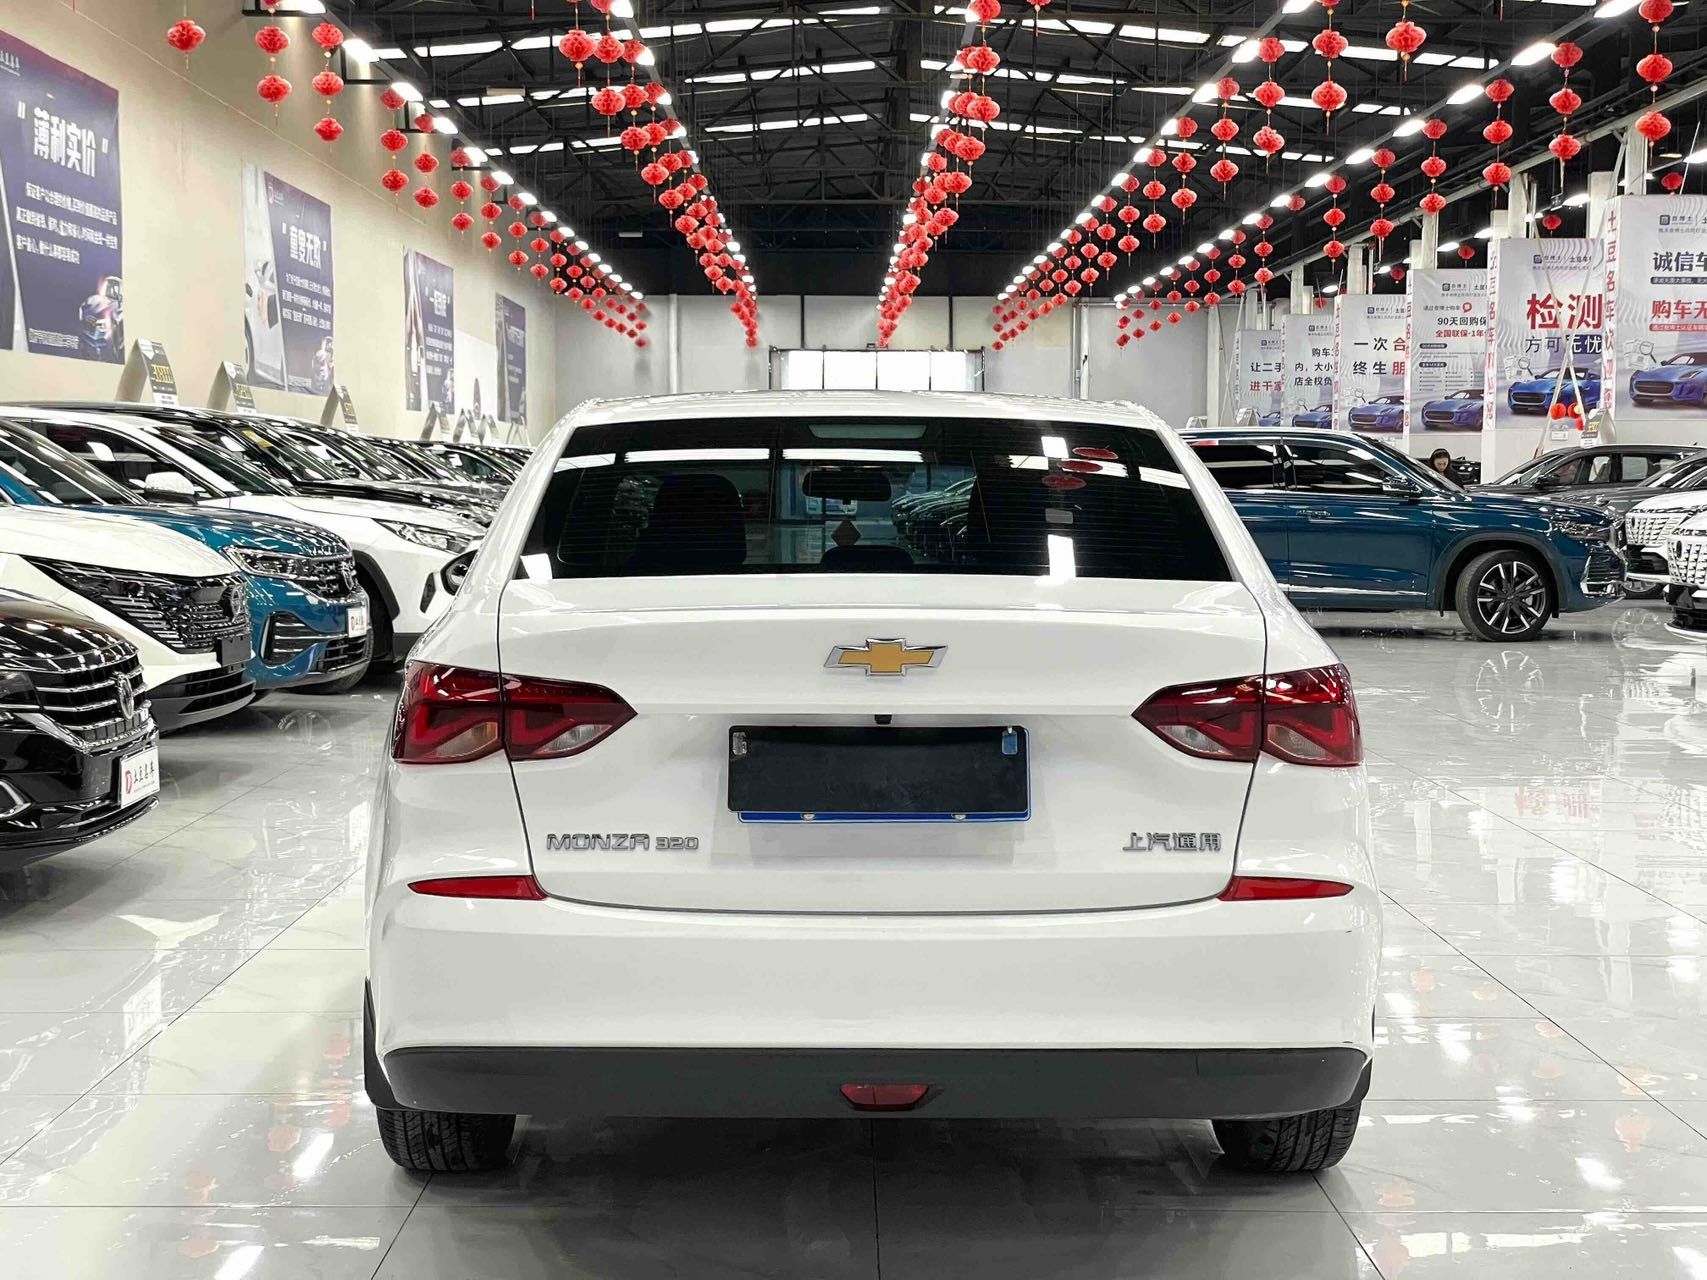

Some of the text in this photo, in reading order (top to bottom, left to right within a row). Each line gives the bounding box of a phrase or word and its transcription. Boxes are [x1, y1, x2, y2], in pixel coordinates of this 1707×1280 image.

[1526, 293, 1604, 331] 检测
[547, 834, 699, 851] MONZA 320
[1122, 832, 1221, 851] 上汽通用
